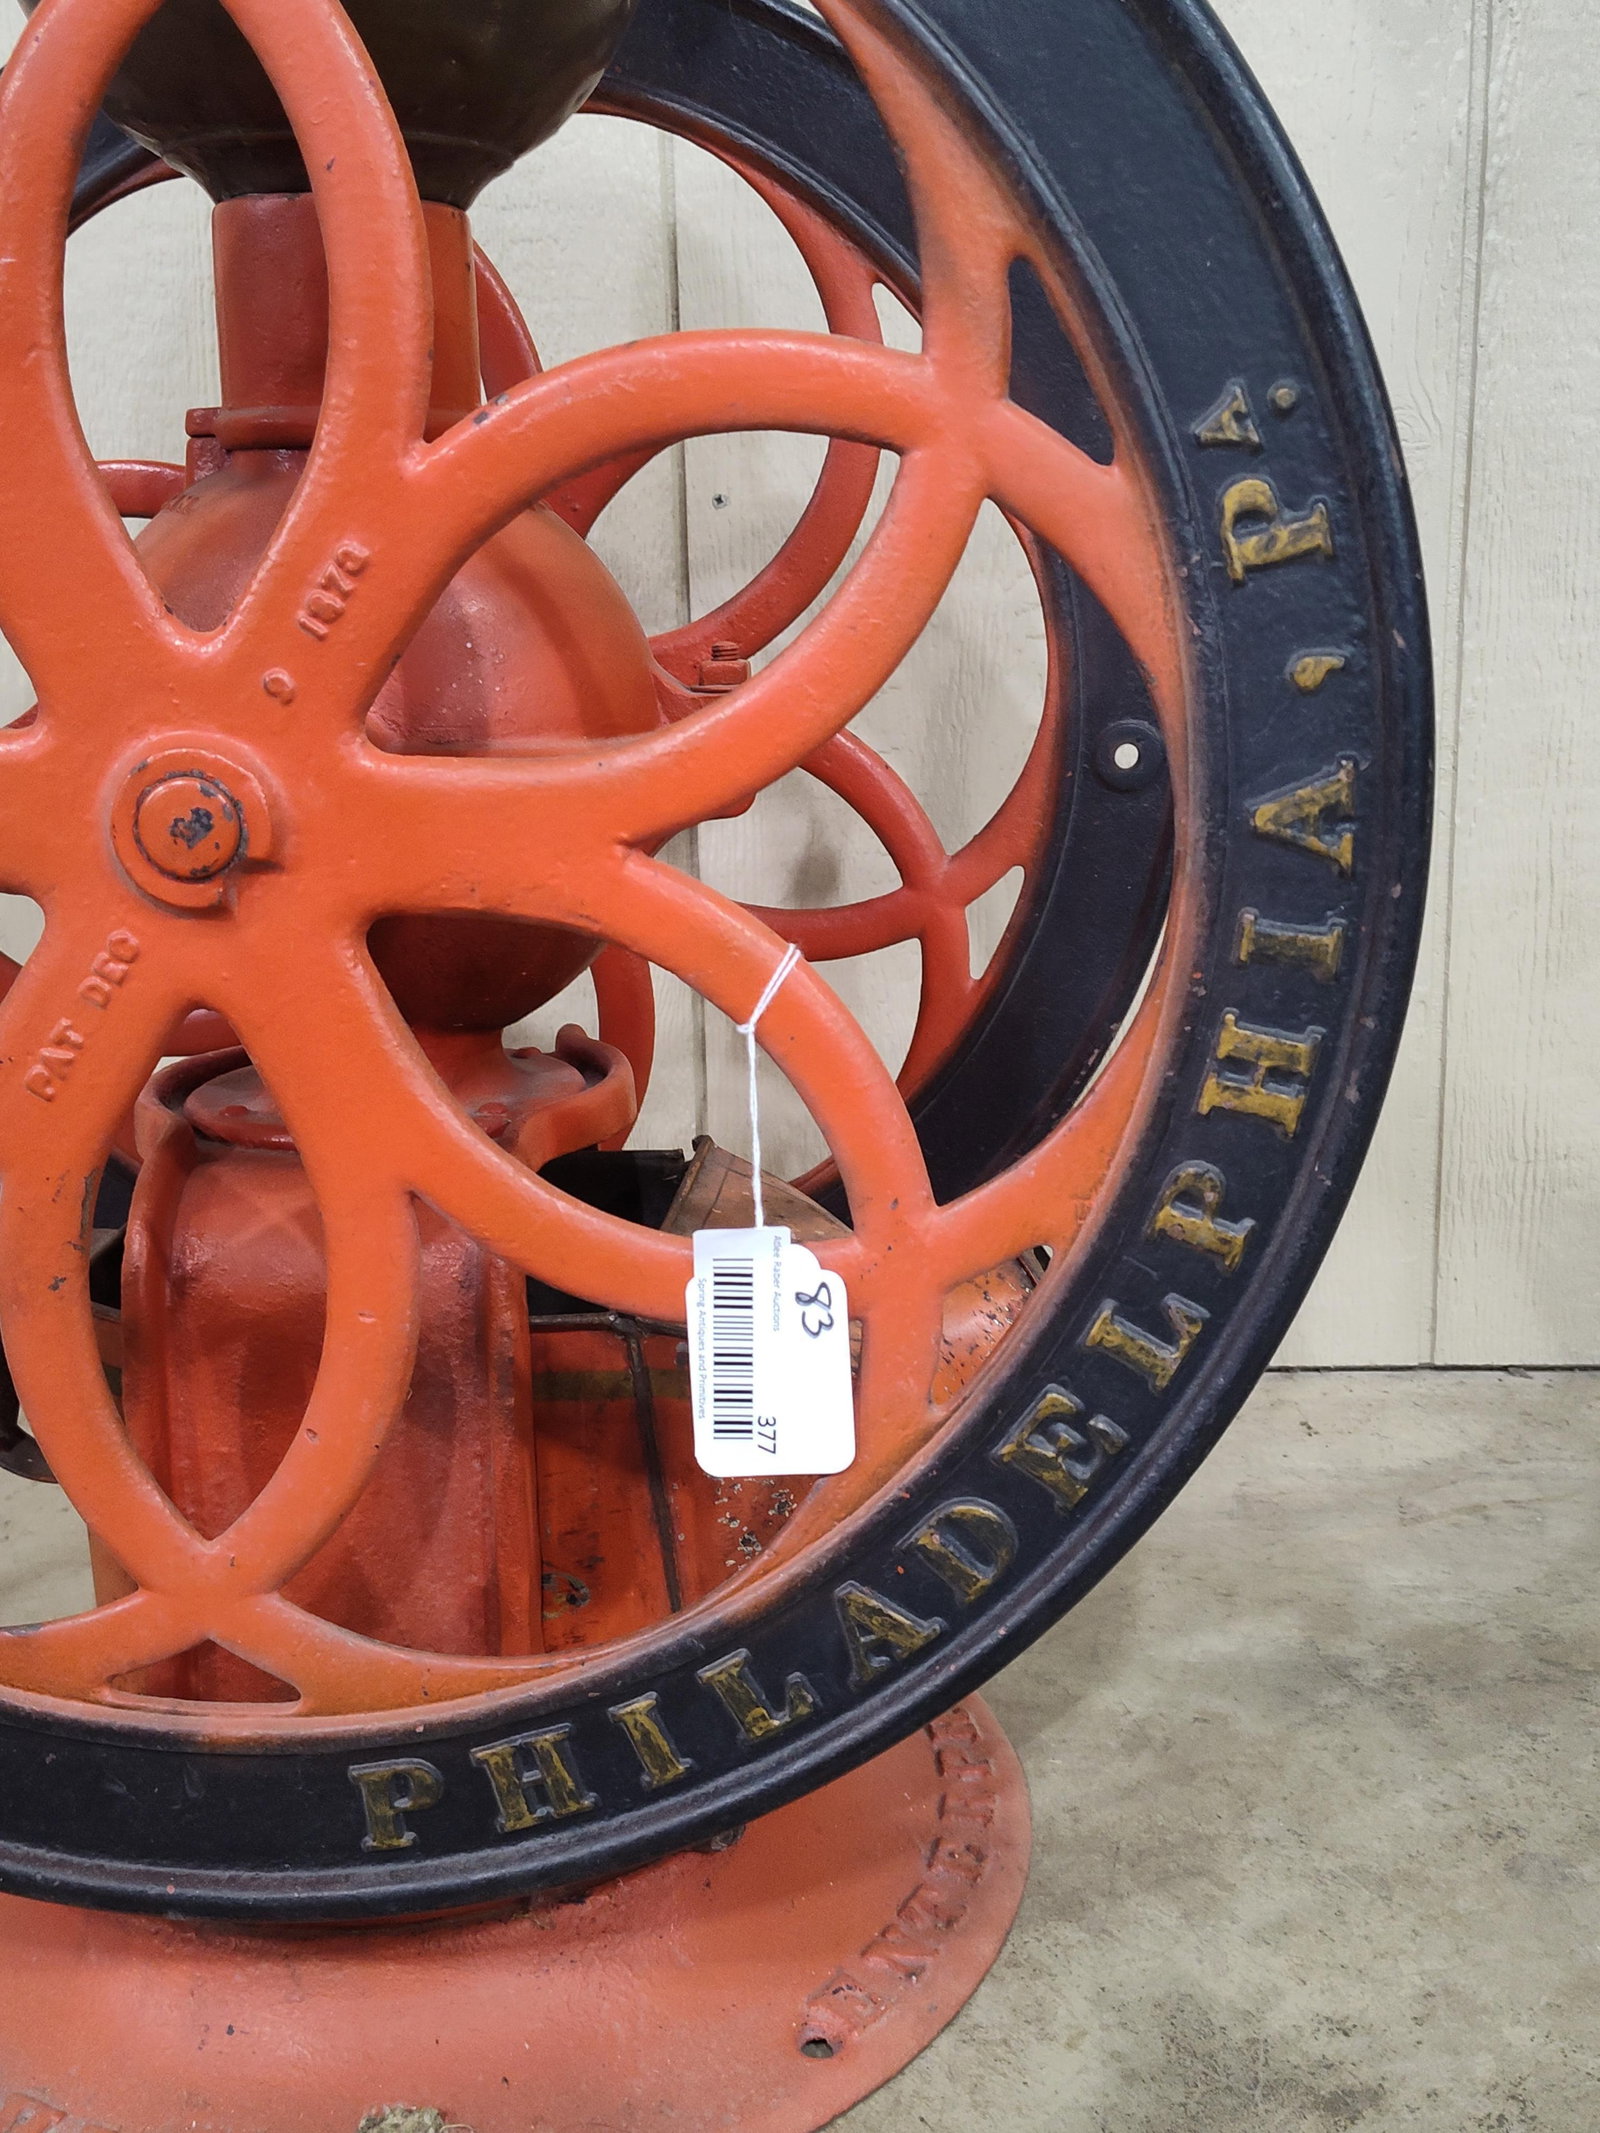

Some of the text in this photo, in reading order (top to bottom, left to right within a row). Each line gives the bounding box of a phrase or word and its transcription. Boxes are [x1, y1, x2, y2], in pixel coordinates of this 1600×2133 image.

[23, 1016, 84, 1102] PAT
[773, 1291, 782, 1332] Auctions
[795, 1281, 835, 1339] 83
[697, 1278, 707, 1420] Spring Antiques and Primitives
[757, 1415, 777, 1455] 377
